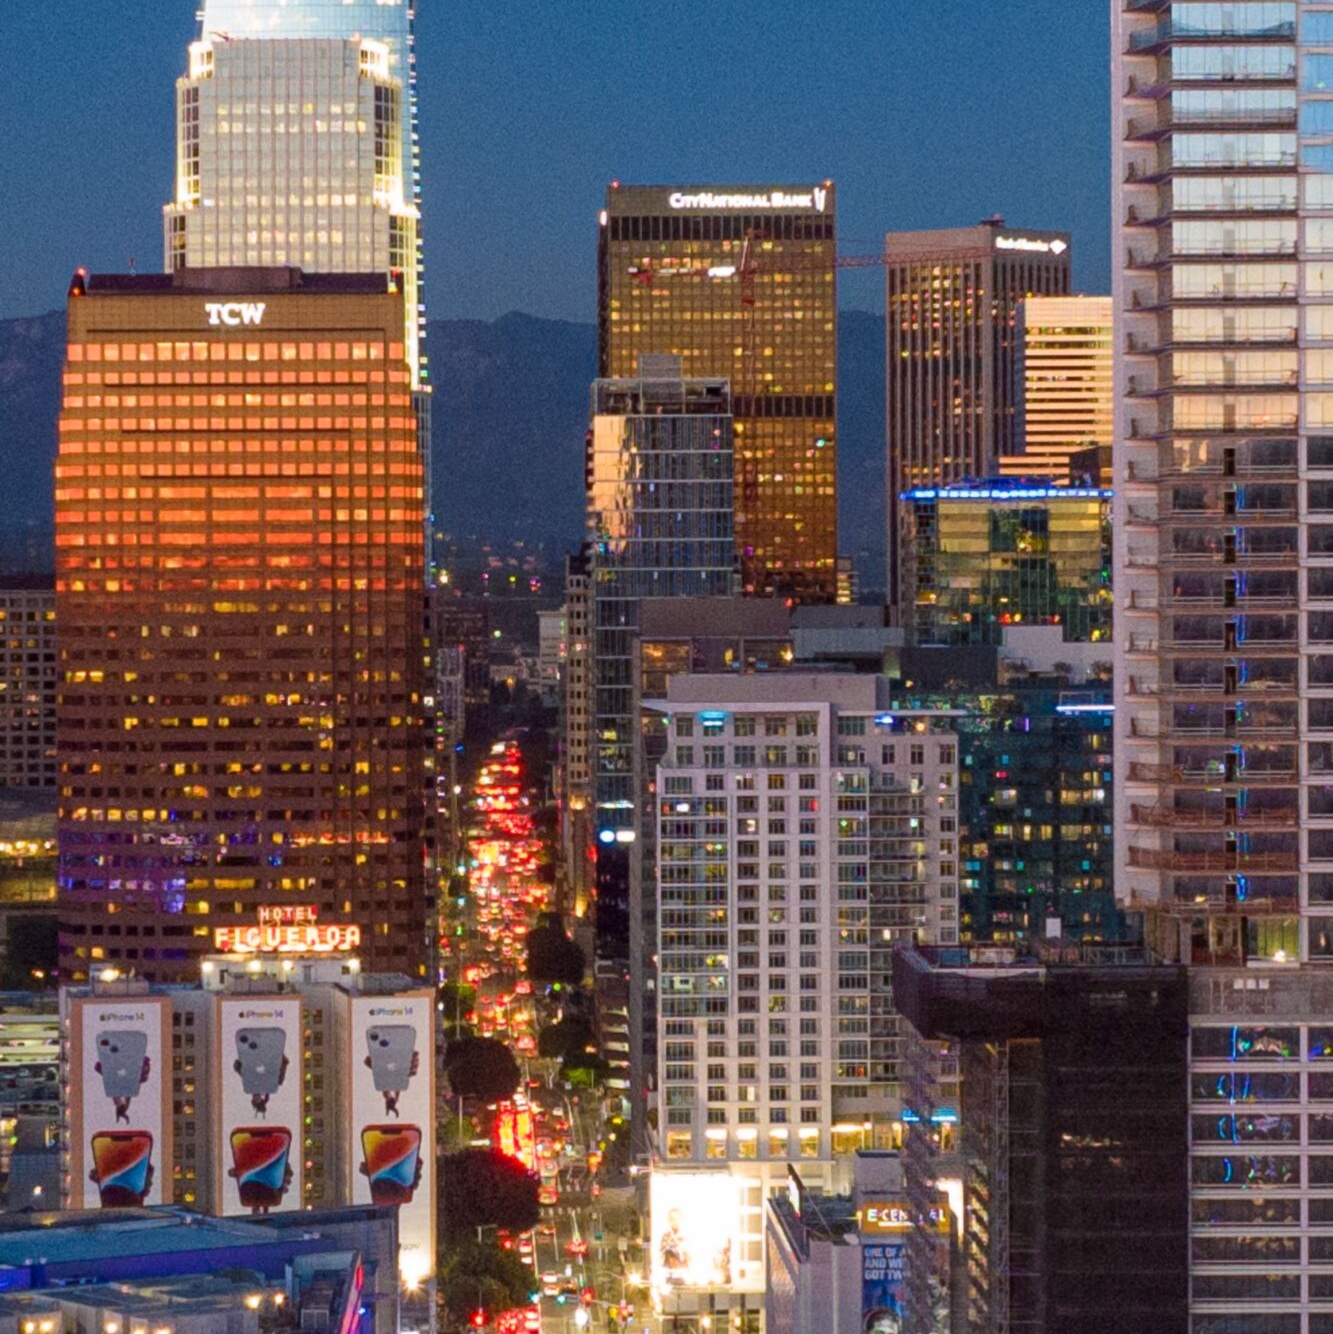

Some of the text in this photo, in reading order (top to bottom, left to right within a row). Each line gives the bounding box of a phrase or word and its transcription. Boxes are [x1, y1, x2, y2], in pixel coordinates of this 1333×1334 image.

[205, 302, 266, 325] TCW
[260, 906, 317, 920] HOTEL
[215, 925, 361, 950] FIGUEROA
